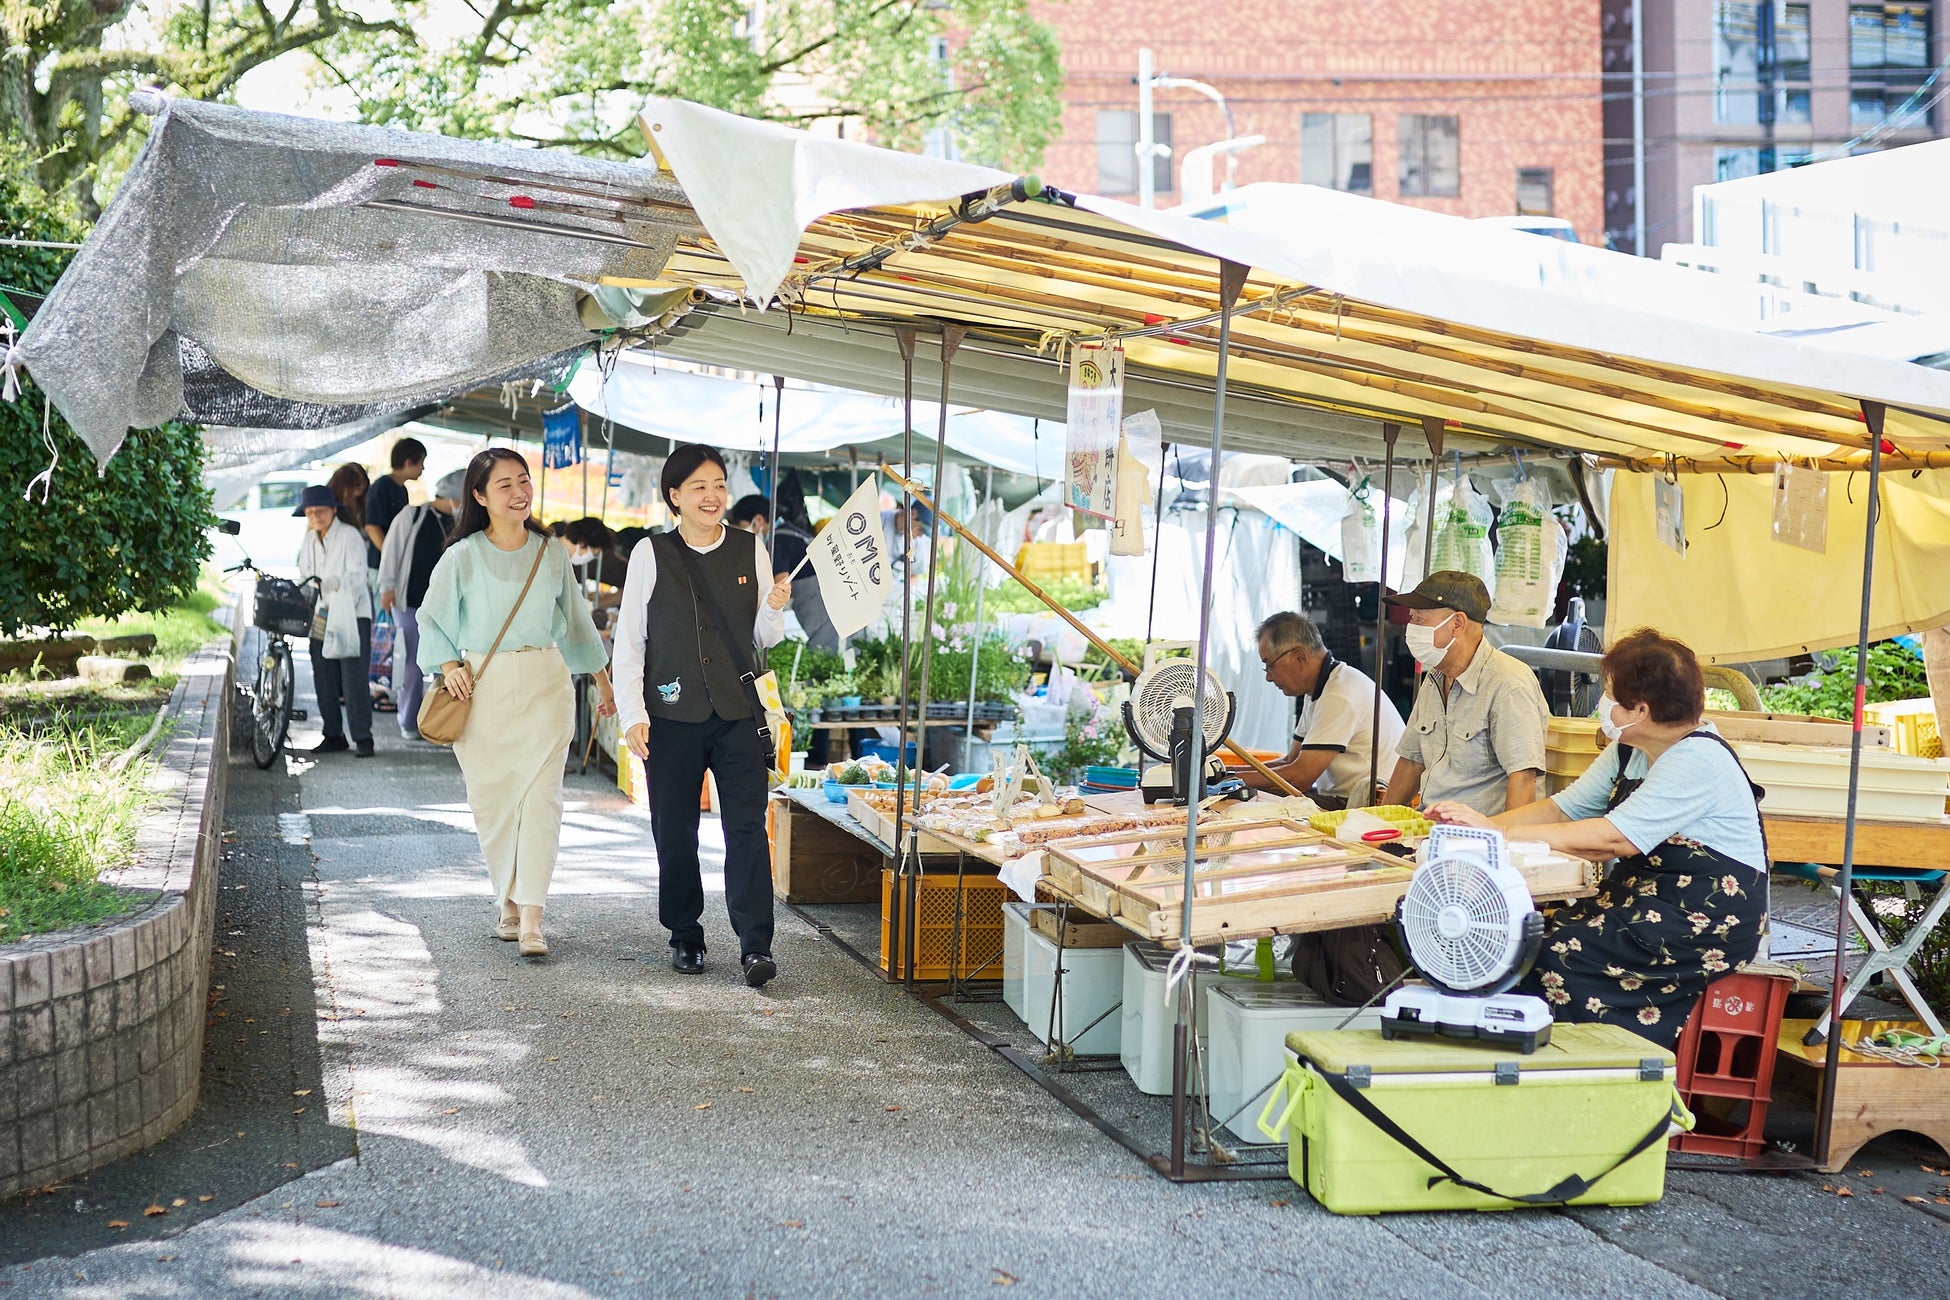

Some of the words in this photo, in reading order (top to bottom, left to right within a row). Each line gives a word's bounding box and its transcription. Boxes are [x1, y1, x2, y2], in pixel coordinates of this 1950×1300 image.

[826, 533, 834, 546] by
[830, 543, 859, 601] 星野リゾート
[846, 512, 881, 586] OMO
